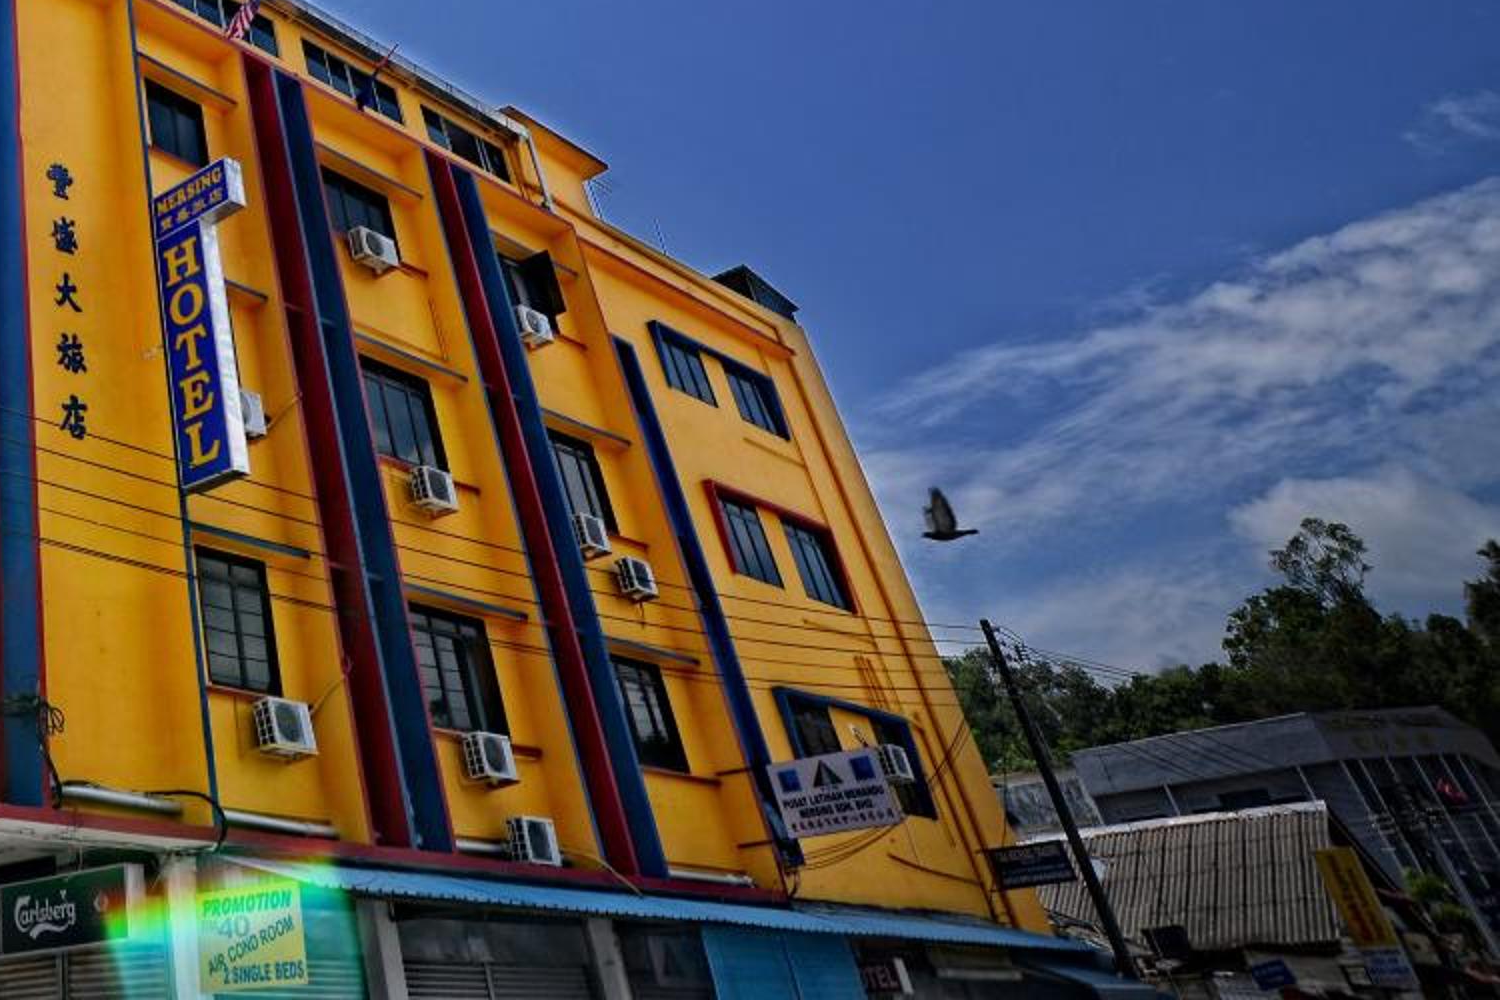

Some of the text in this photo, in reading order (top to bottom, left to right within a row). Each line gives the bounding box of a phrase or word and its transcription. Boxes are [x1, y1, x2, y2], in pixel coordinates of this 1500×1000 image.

[157, 167, 221, 216] MERSING
[164, 236, 221, 469] HOTEL
[14, 892, 76, 936] Carlsberg
[203, 889, 293, 917] PROMOTION
[260, 913, 295, 946] ROOM
[232, 962, 272, 984] SINGLE
[275, 959, 305, 981] BEDS
